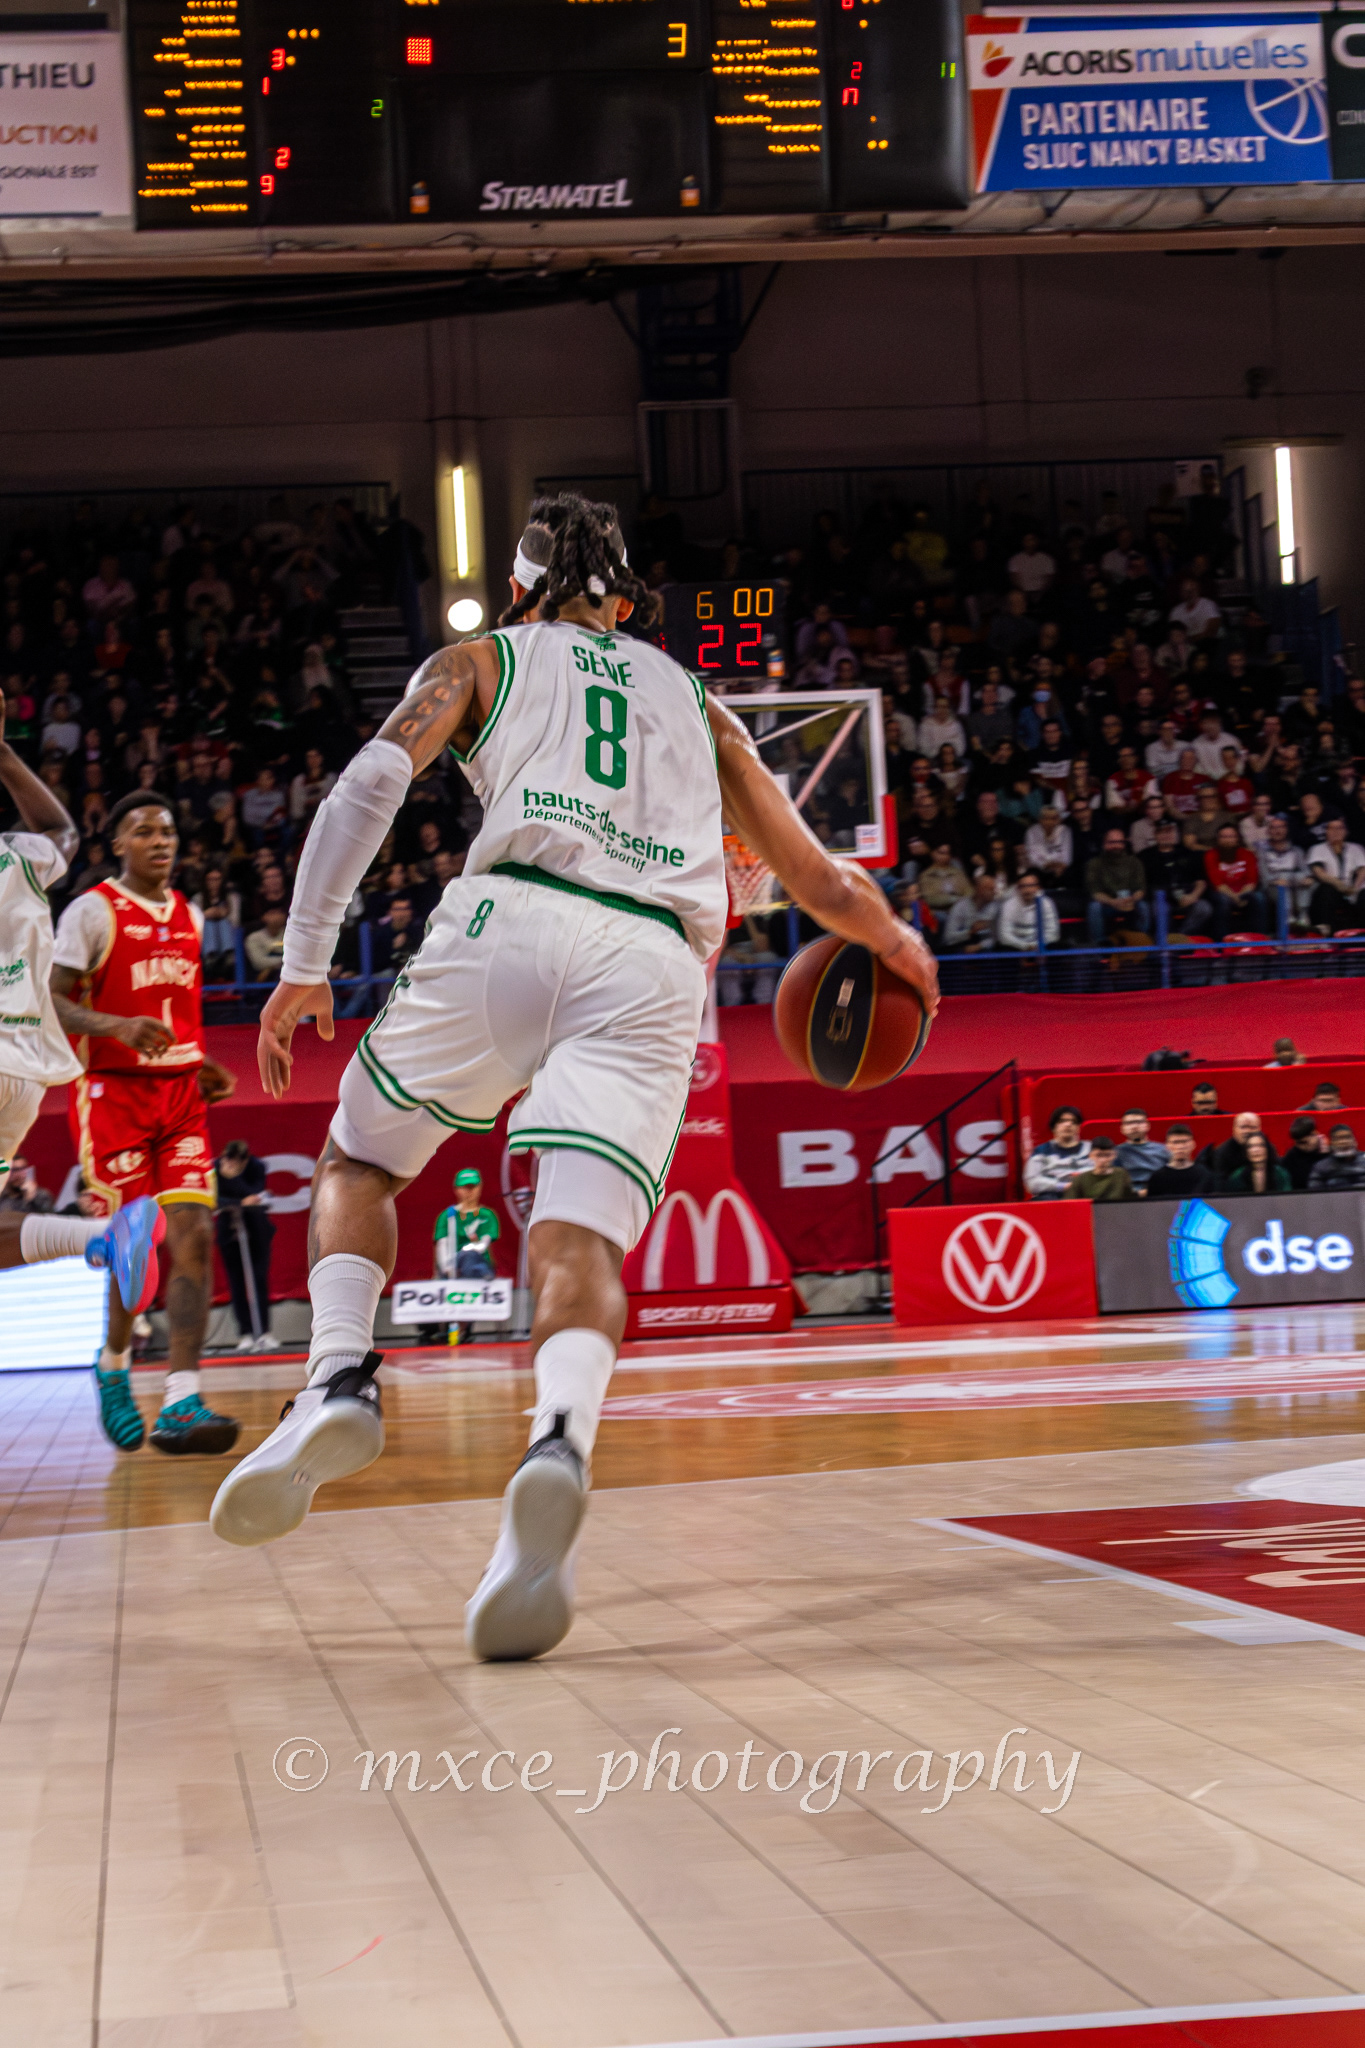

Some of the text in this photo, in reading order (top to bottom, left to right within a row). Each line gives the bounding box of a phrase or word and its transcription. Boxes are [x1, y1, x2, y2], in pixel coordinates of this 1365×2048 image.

[271, 48, 285, 70] 3
[850, 61, 863, 80] 2
[370, 98, 384, 118] 2
[1020, 97, 1210, 136] PARTENAIRE
[274, 147, 291, 169] 2
[1022, 136, 1268, 170] SLUC NANCY BASKET
[260, 174, 275, 195] 9
[479, 178, 633, 211] STRAMATEL
[696, 588, 774, 619] 6 00
[584, 684, 628, 791] 8
[465, 898, 495, 940] 8
[1242, 1218, 1354, 1276] dse
[398, 1286, 506, 1307] Polaris
